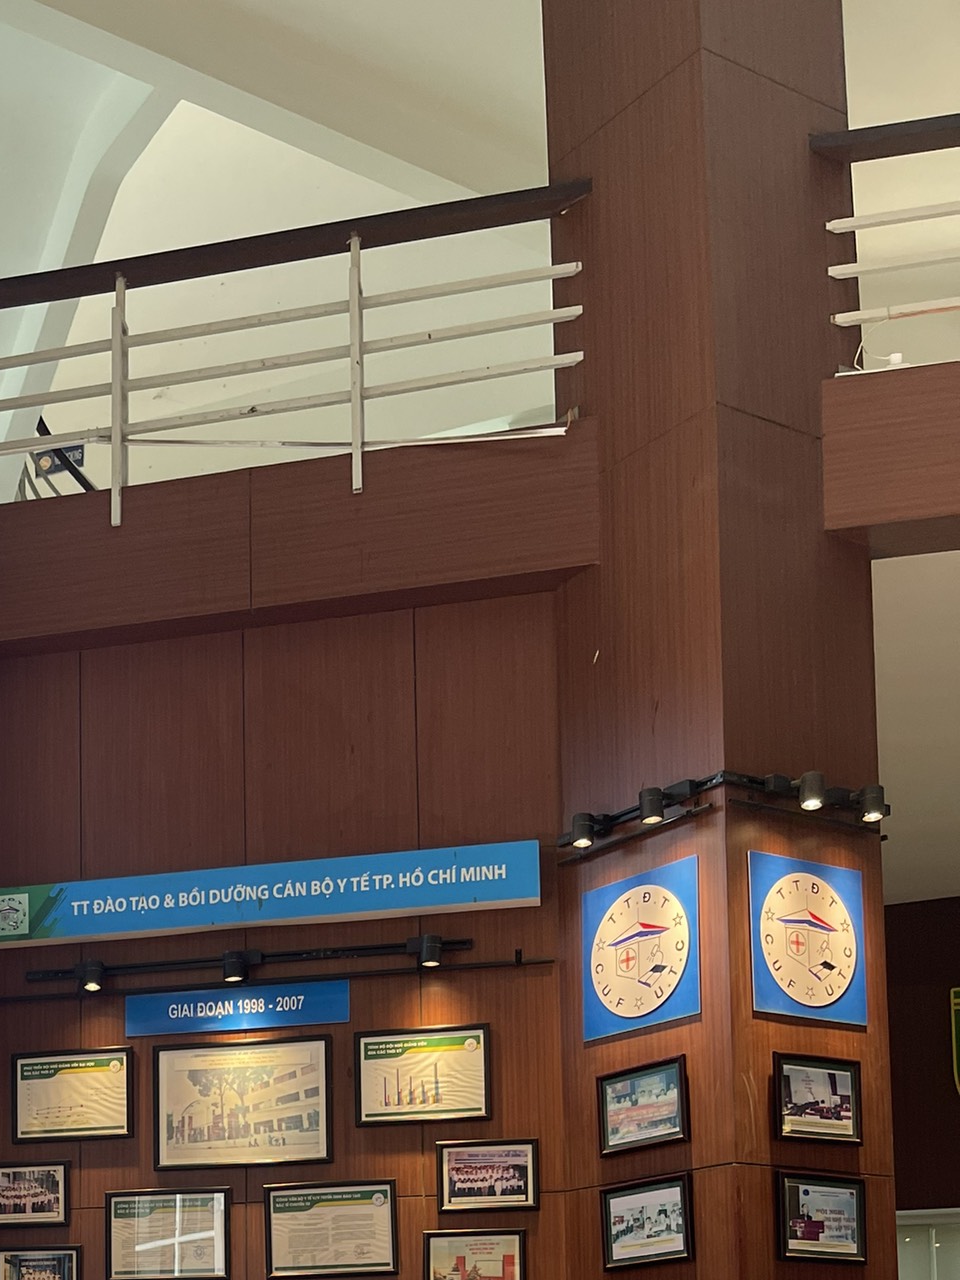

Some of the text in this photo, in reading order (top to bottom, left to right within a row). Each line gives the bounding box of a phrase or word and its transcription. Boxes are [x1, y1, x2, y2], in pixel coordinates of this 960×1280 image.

[71, 863, 507, 915] TT ĐÀO TẠO & BỒI DƯỠNG CÁN BỘ Y TẾ TP. HỒ CHÍ MINH
[168, 1003, 194, 1019] GIAI
[197, 1000, 234, 1019] ĐOẠN
[237, 998, 265, 1014] 1998
[275, 995, 305, 1011] 2007
